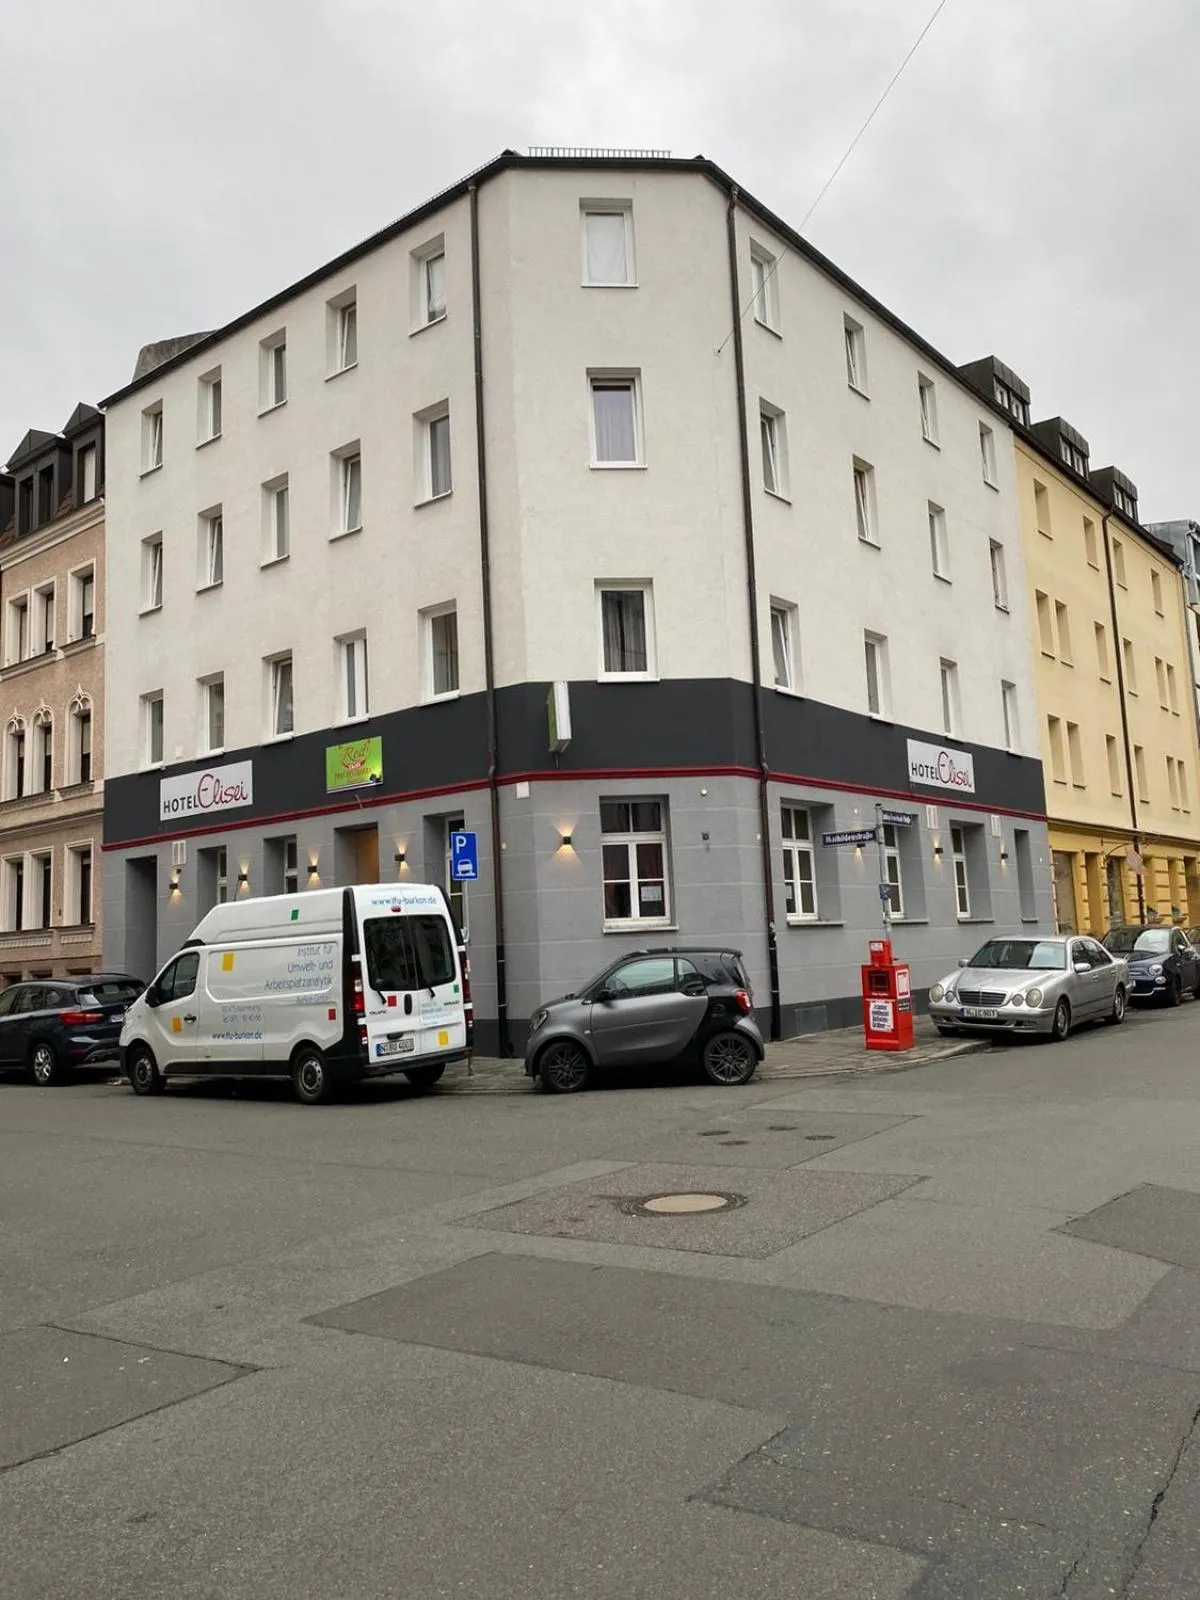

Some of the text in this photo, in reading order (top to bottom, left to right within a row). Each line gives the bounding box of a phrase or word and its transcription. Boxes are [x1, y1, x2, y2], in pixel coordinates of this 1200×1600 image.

[911, 751, 972, 788] HOTEL Elisei
[163, 773, 249, 814] HOTEL Elisei
[455, 835, 467, 854] P
[287, 960, 334, 973] Umwelt- und
